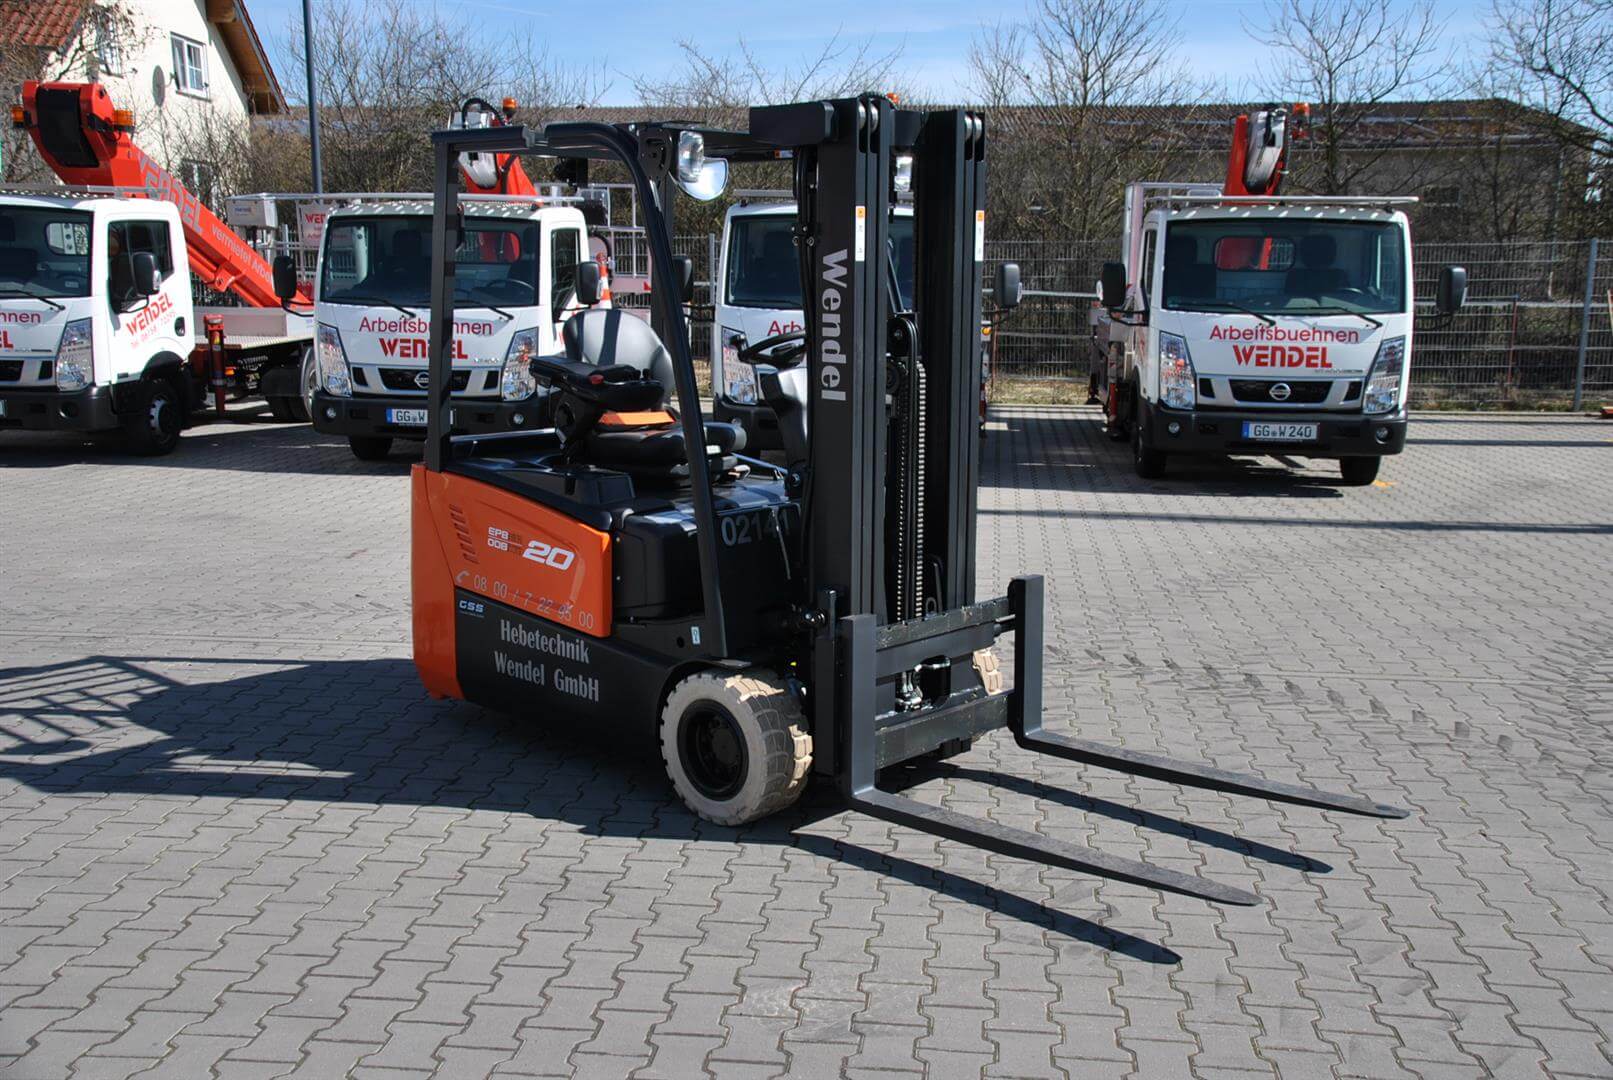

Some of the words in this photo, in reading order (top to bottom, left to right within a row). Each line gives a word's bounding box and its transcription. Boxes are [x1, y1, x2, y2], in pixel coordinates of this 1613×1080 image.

[126, 292, 173, 336] WENDEL
[821, 249, 848, 401] Wendel
[359, 317, 493, 335] Arbeitsbnen
[1209, 325, 1360, 343] Arbeitsbuehnen
[379, 338, 468, 359] WENL
[1232, 345, 1333, 368] WENDEL
[396, 411, 411, 422] GG
[1254, 425, 1270, 437] GG
[522, 540, 575, 571] 20
[500, 618, 590, 664] Hebetechnik
[494, 651, 545, 686] Wendel
[553, 667, 599, 702] GmbH
